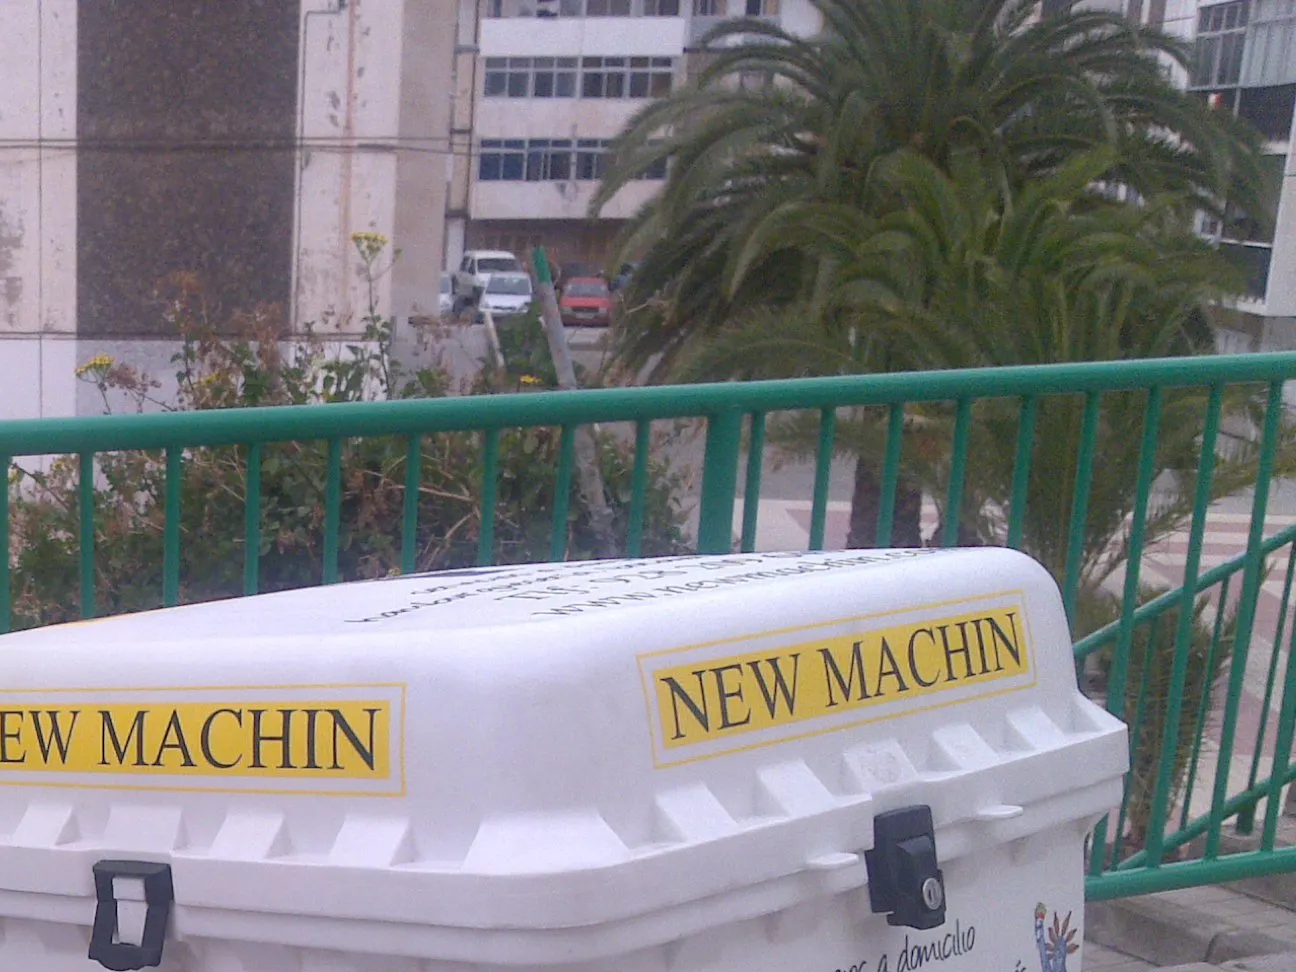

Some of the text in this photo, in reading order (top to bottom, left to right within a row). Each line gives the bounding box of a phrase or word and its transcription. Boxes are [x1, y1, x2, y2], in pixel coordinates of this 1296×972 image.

[660, 612, 1021, 740] NEW MACHIN
[97, 708, 382, 772] MACHIN
